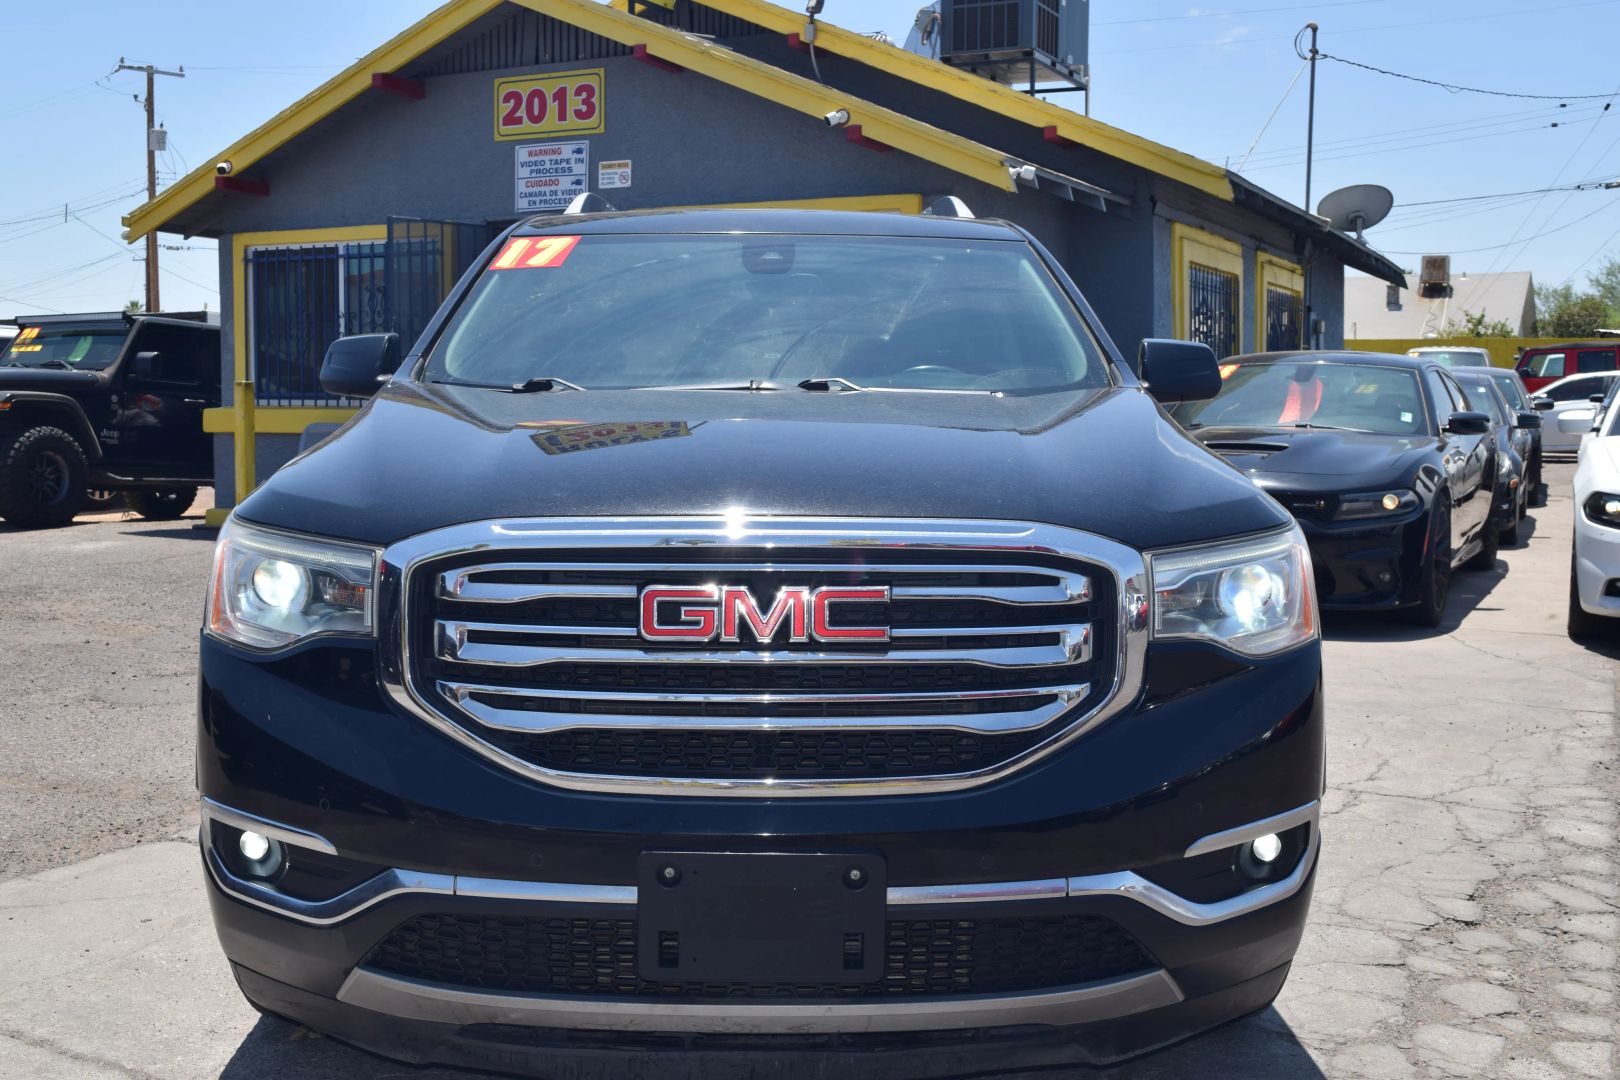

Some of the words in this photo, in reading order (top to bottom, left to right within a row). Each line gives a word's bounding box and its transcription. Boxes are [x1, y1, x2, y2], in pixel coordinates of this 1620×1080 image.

[501, 83, 597, 127] 2013
[527, 147, 562, 158] WARNING
[520, 159, 546, 168] VIDEO
[549, 157, 571, 166] TAPE
[529, 166, 573, 175] PROCESS
[525, 178, 560, 188] CUIDADO
[519, 190, 547, 199] CAMARA
[549, 189, 559, 197] DE
[561, 188, 584, 196] VIDEO
[540, 197, 572, 206] PROCESO
[495, 237, 575, 268] 17
[640, 584, 891, 642] GMC
